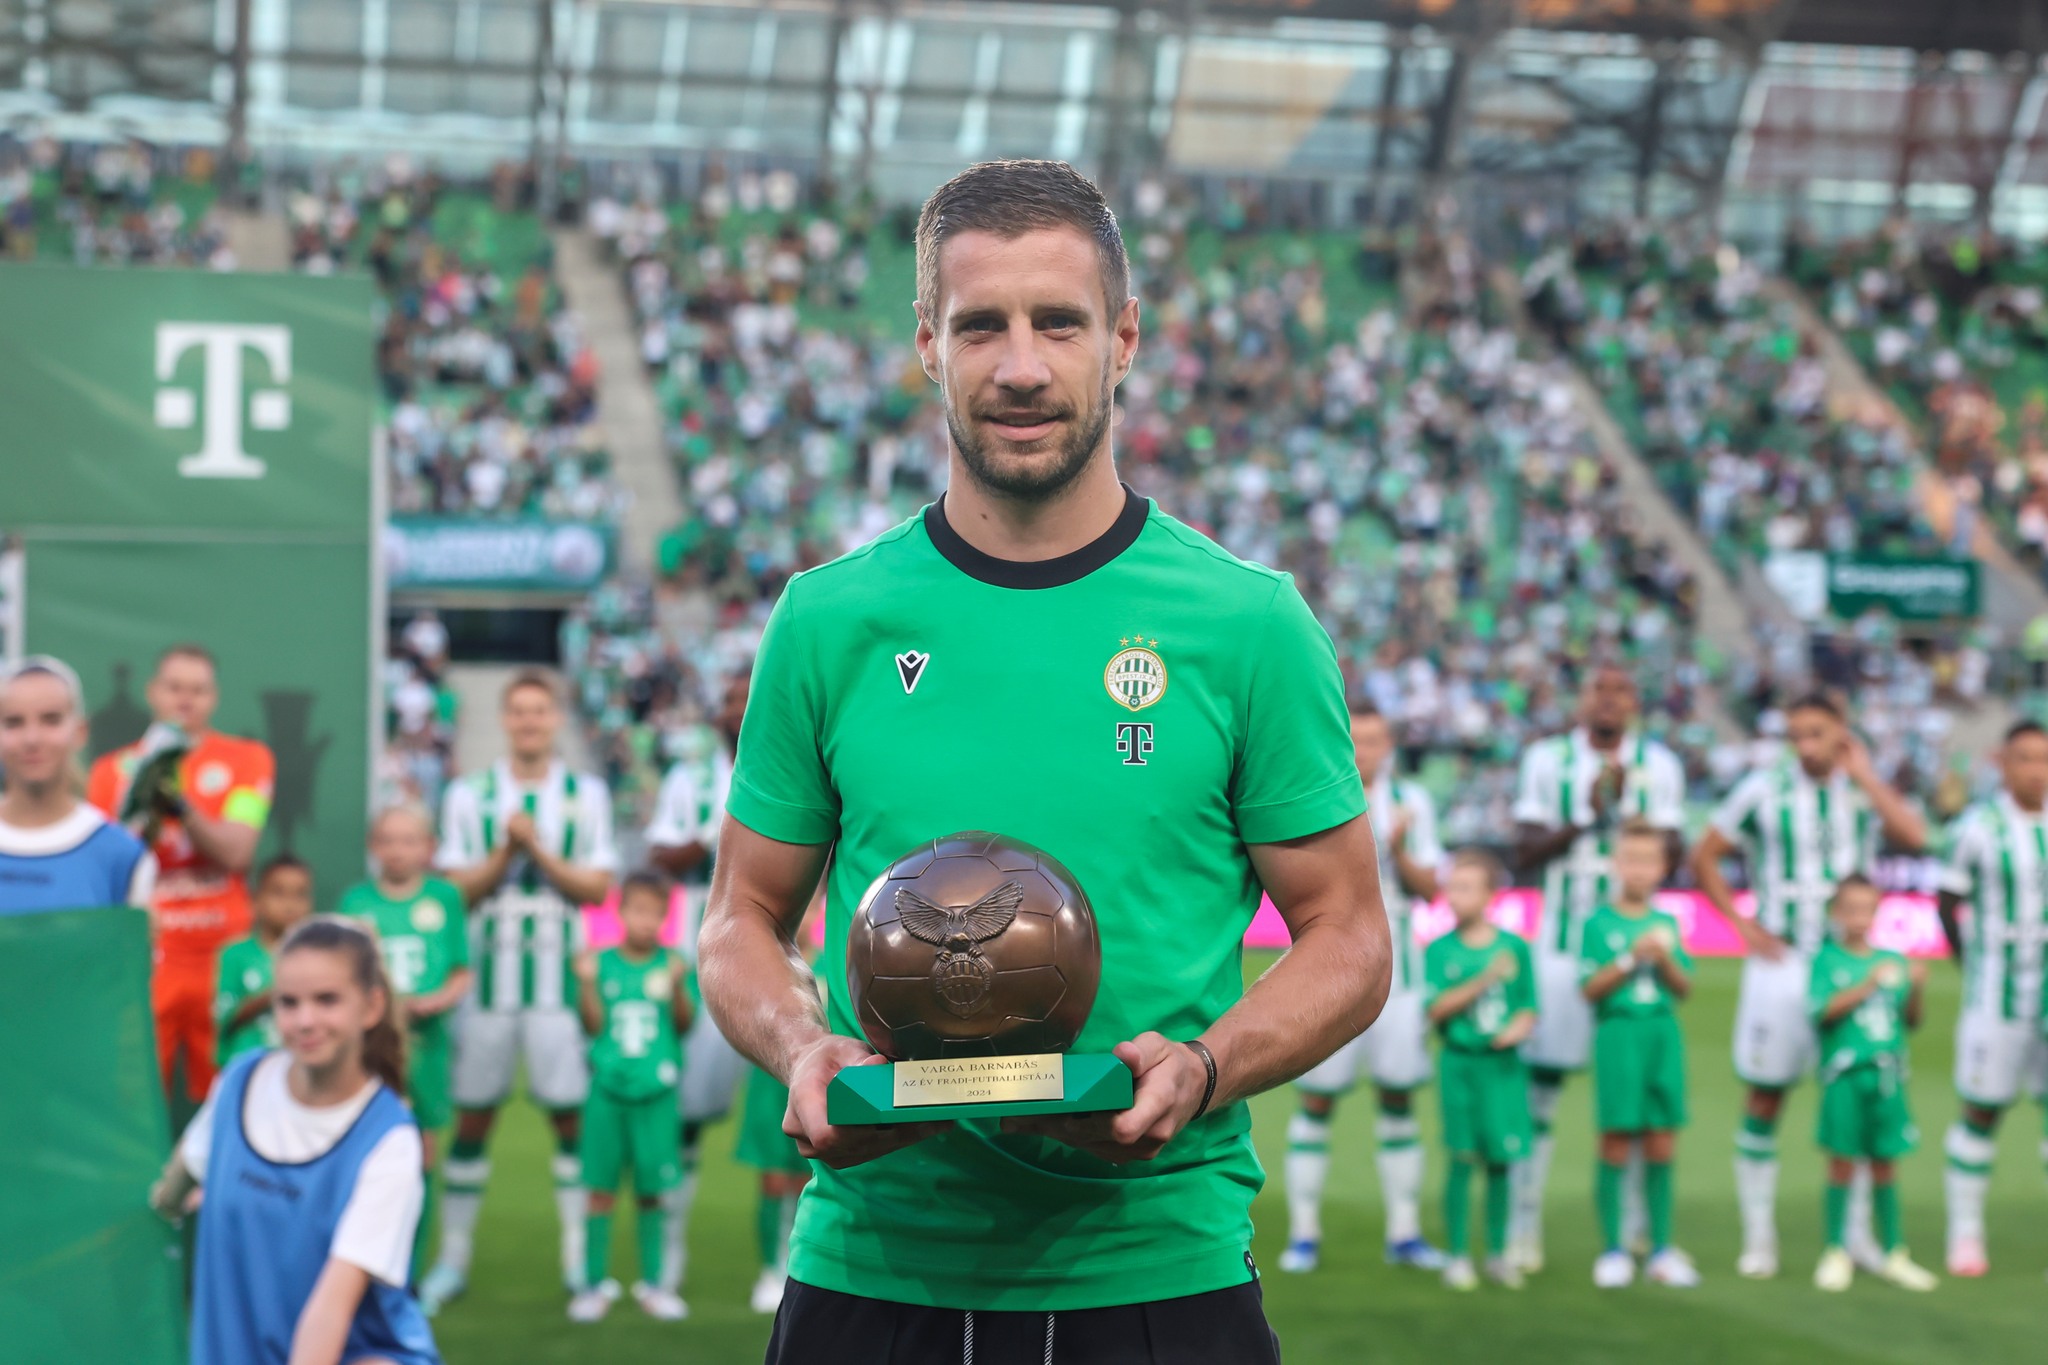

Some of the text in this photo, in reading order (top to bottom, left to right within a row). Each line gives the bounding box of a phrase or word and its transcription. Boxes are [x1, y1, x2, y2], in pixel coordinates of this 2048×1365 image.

[155, 322, 291, 478] T
[1117, 723, 1153, 765] T
[920, 1060, 1038, 1073] VARGA BARNABÁS
[938, 1073, 1055, 1085] FRADI-FUTBALLISTÁJA
